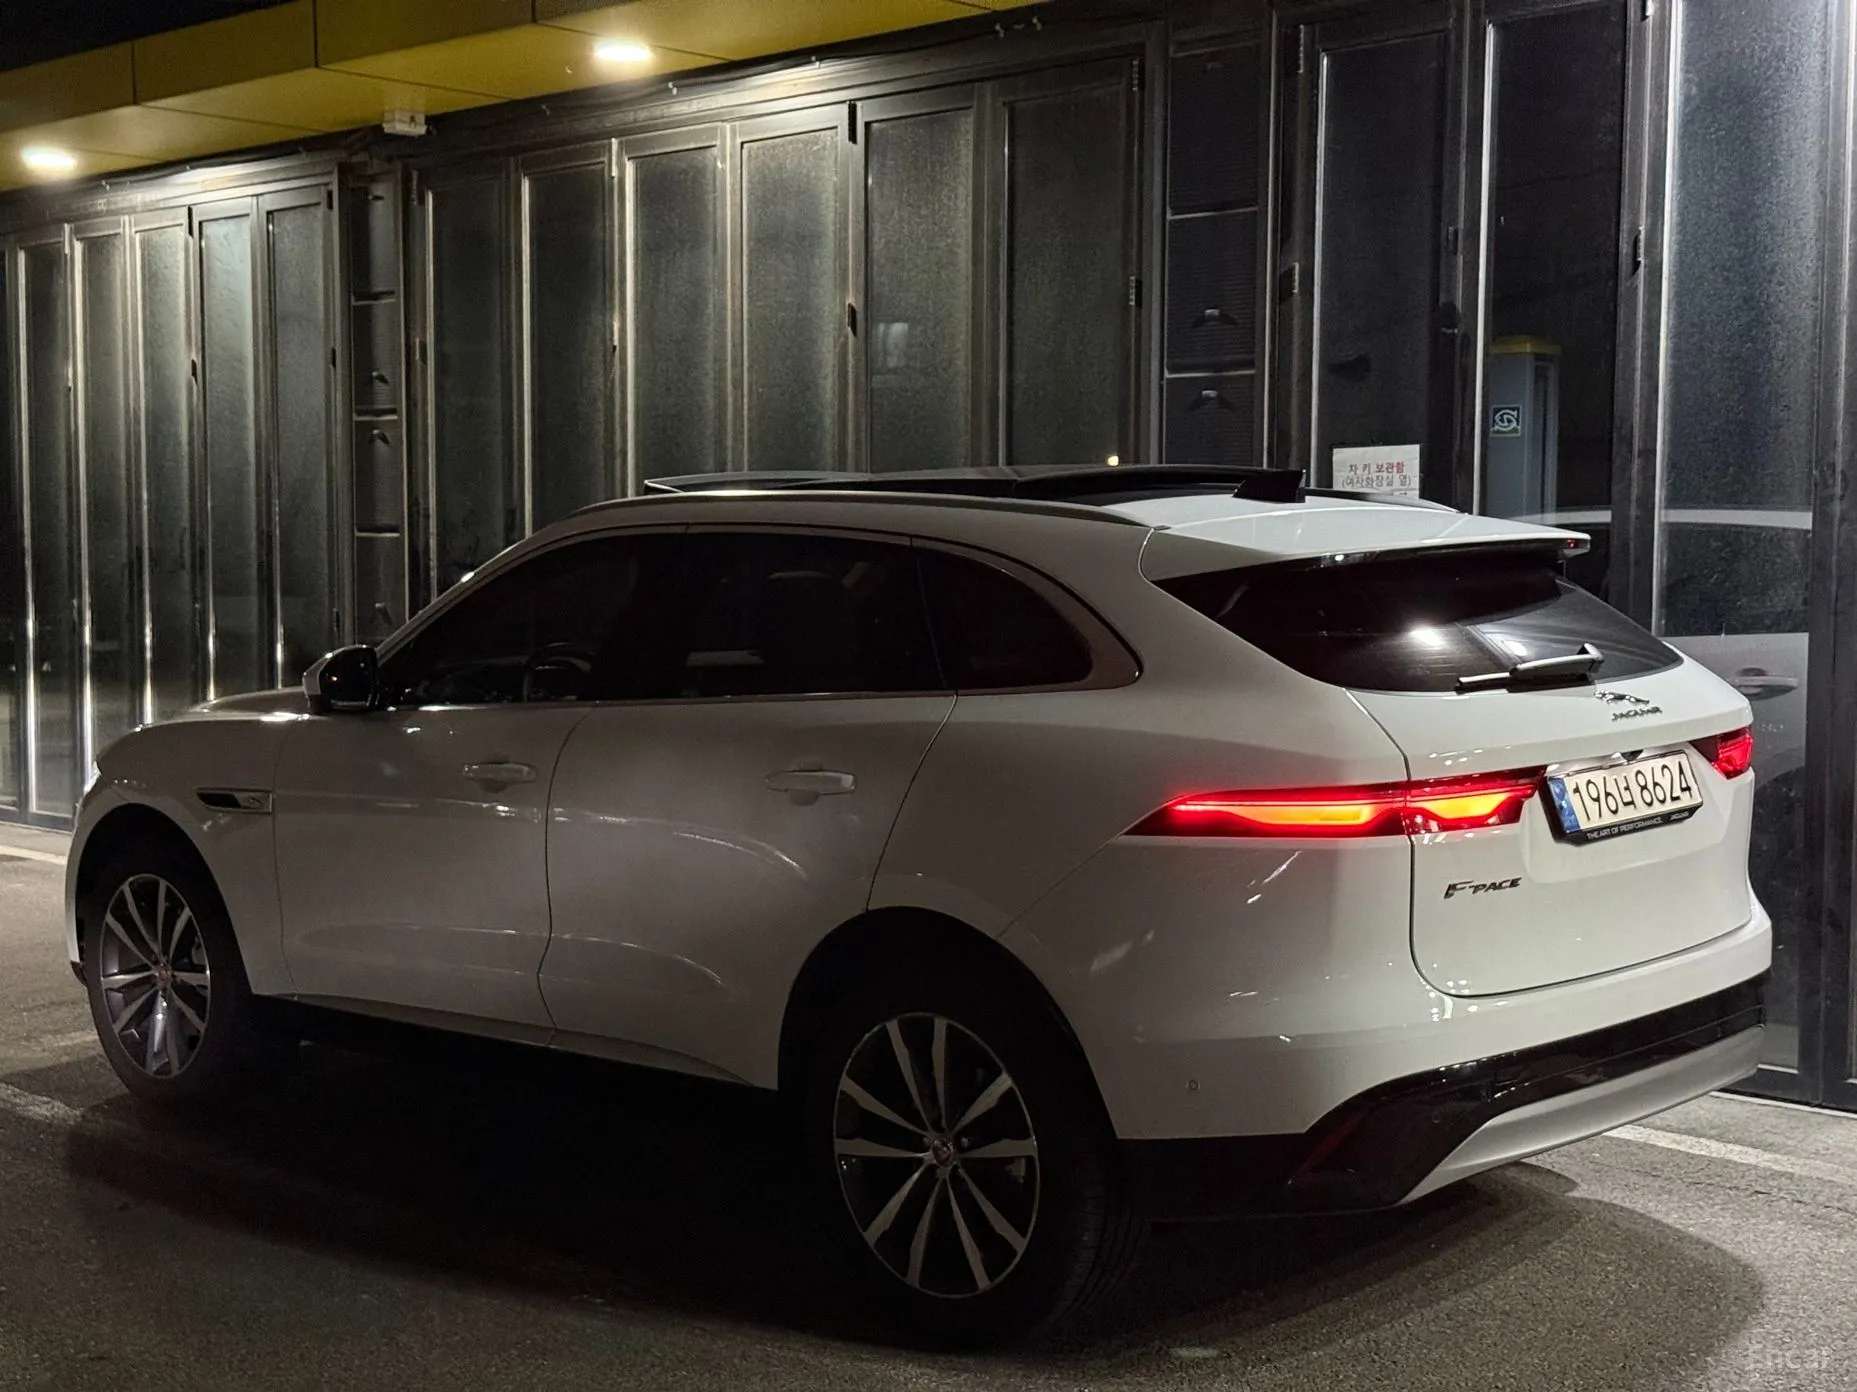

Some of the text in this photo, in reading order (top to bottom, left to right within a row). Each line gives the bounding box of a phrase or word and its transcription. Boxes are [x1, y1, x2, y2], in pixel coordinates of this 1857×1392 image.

[1362, 462, 1371, 475] 키
[1375, 462, 1404, 473] 보관함
[1635, 761, 1692, 807] 8624
[1619, 817, 1662, 832] PERFORMANCE
